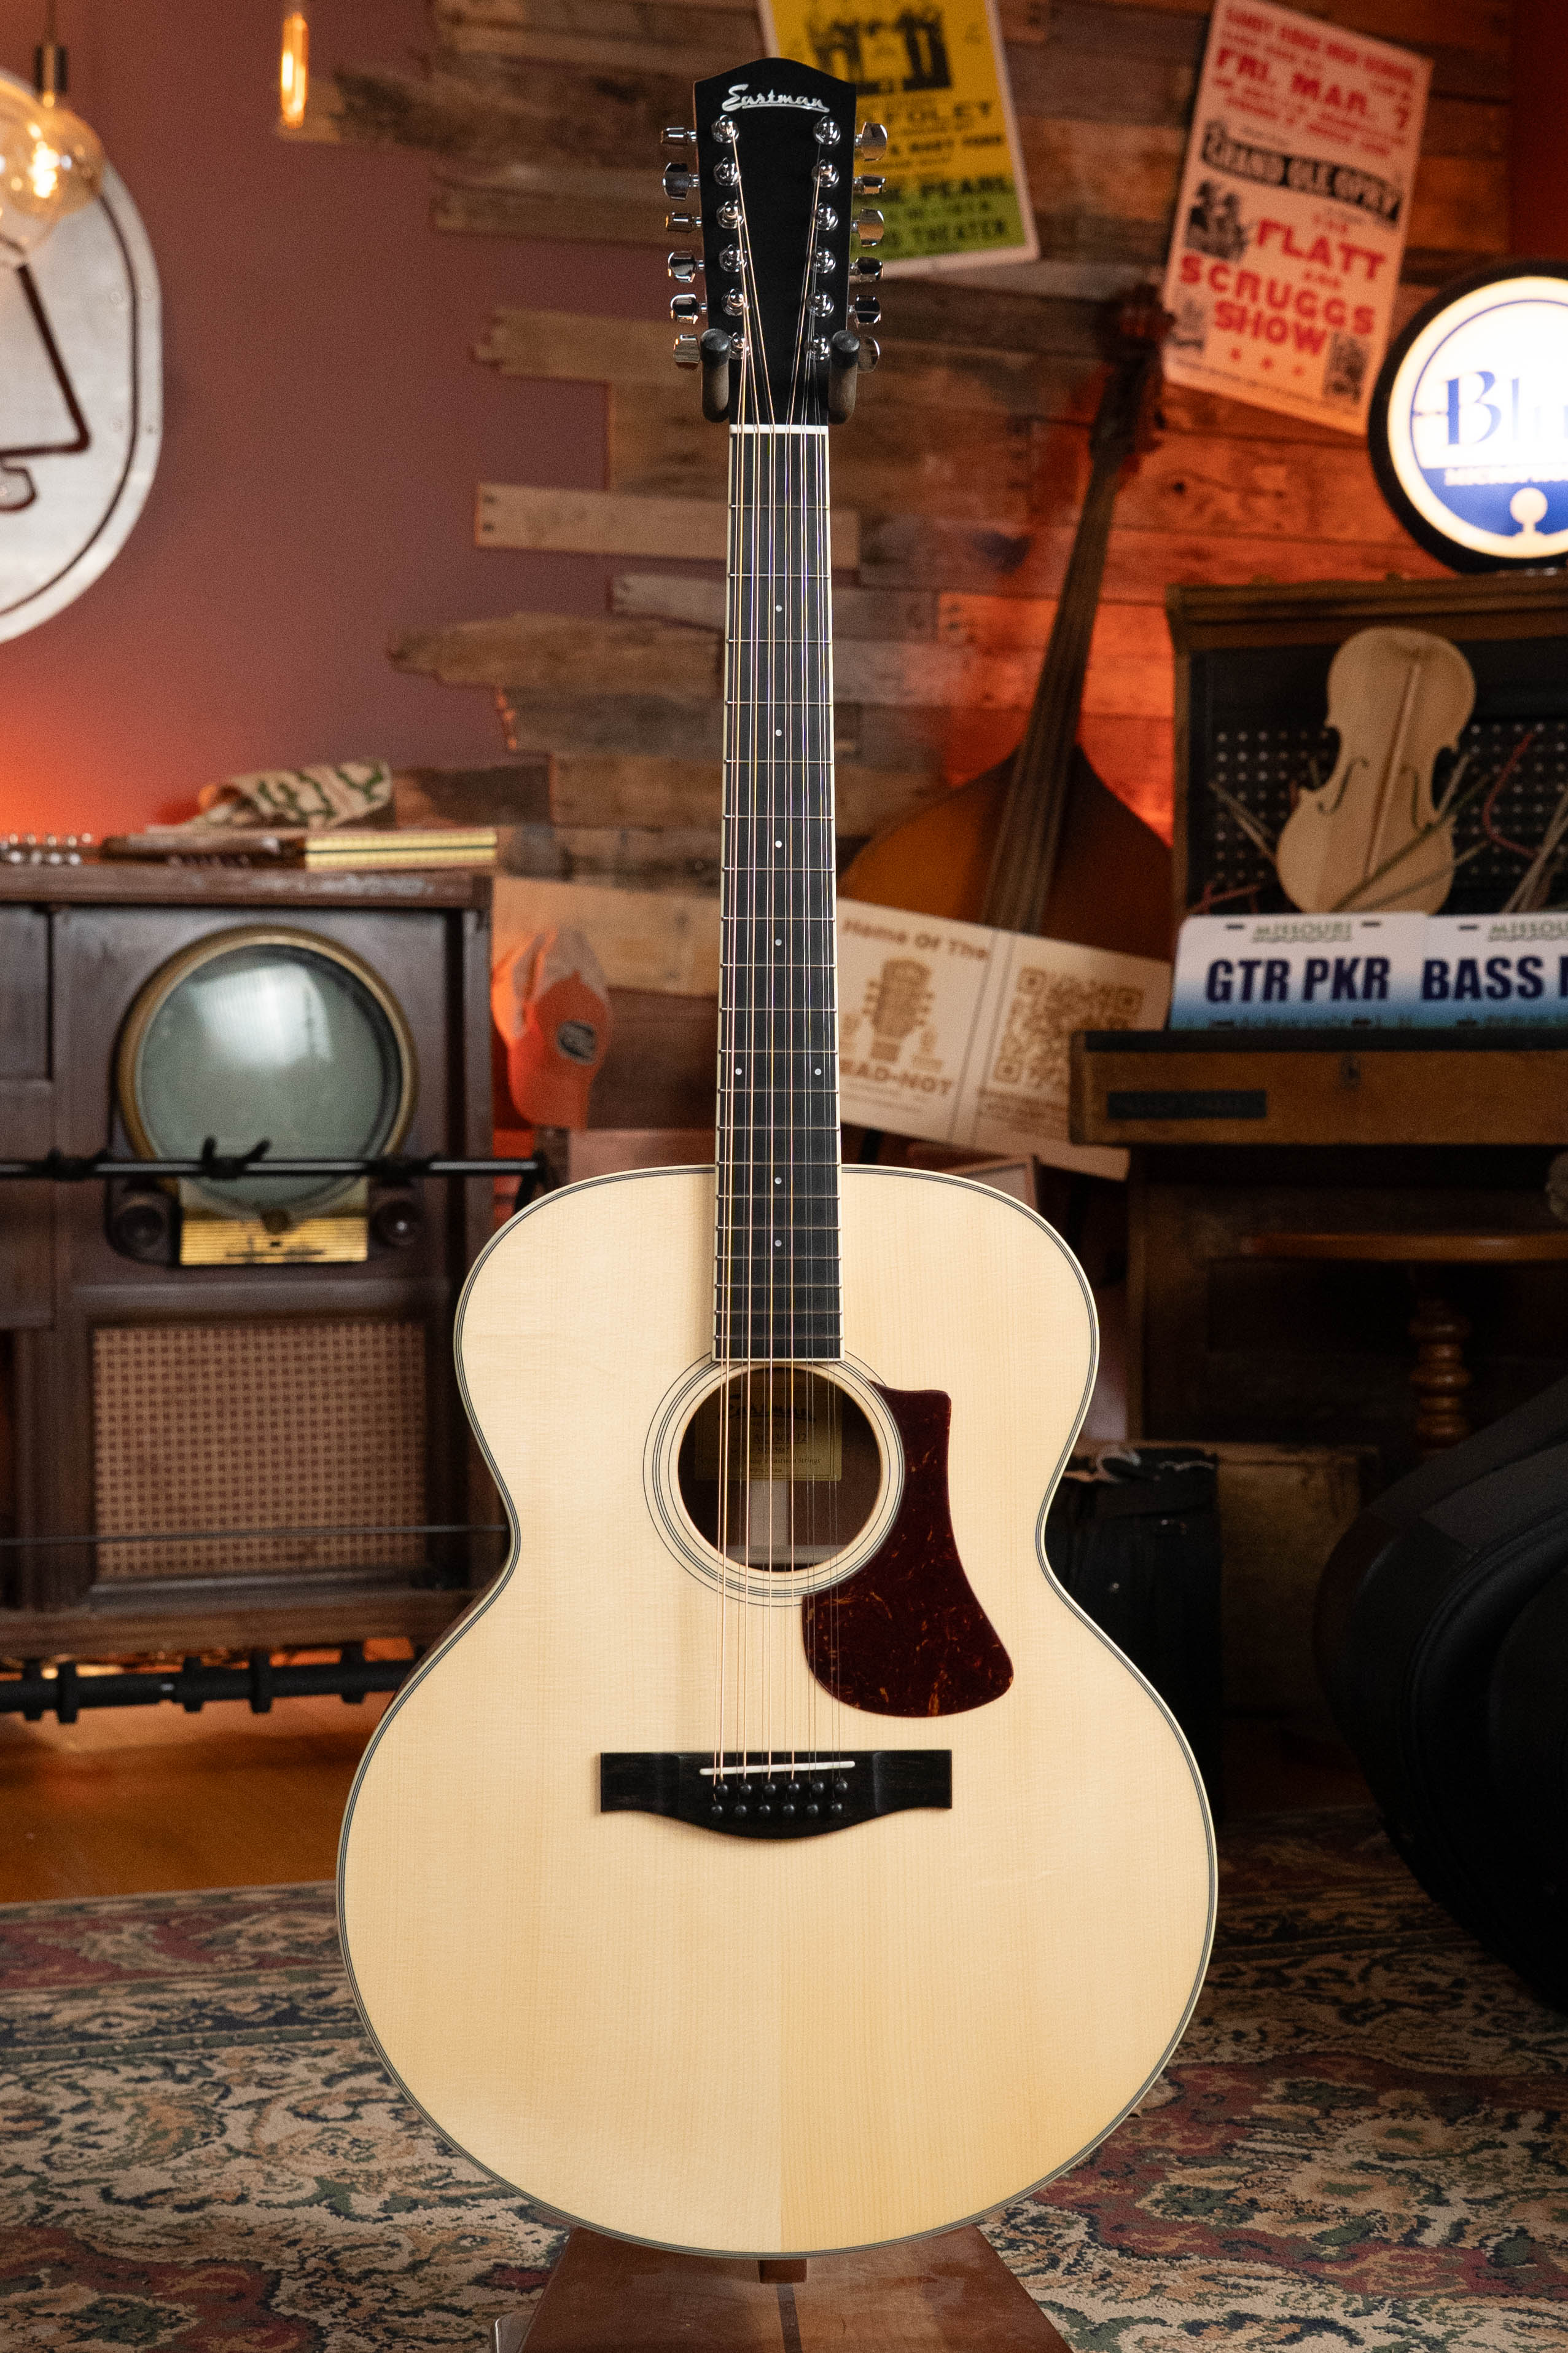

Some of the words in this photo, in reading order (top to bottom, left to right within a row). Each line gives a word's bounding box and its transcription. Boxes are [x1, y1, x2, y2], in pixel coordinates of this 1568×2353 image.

[722, 84, 830, 112] Eastman
[1257, 217, 1386, 280] FLATT
[1180, 254, 1375, 336] SCRUGGS
[1214, 300, 1328, 356] SHOW
[843, 919, 907, 944] Home
[914, 933, 941, 950] Of
[948, 940, 989, 960] The
[1207, 958, 1290, 1002] GTR
[1302, 955, 1391, 1002] PKR
[1421, 955, 1544, 1001] BASS
[839, 1058, 953, 1095] EAD-NOT
